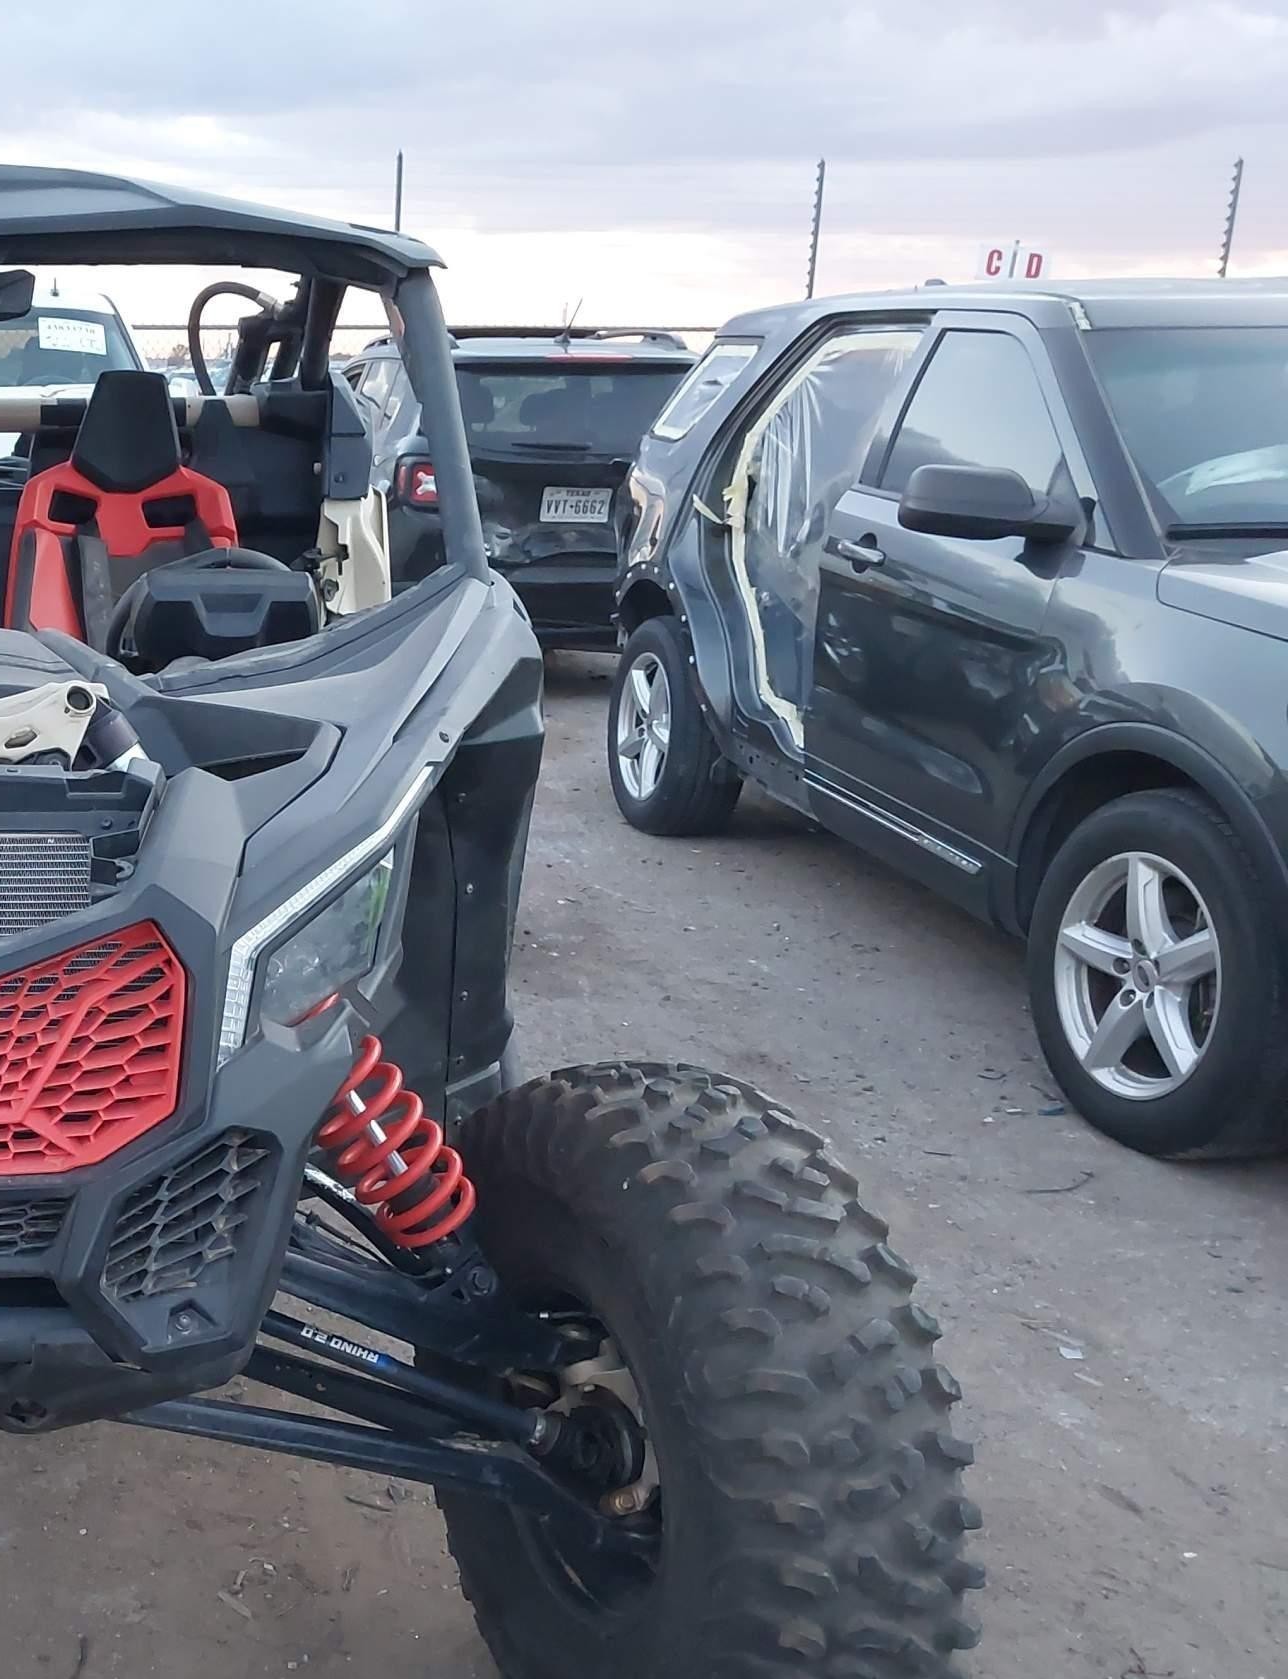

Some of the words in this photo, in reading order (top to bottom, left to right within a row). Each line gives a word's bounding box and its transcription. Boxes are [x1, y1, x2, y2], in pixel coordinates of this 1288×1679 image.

[985, 248, 1003, 276] C
[1025, 252, 1043, 279] D
[300, 1326, 328, 1345] 2.0
[329, 1337, 380, 1364] RHINO
